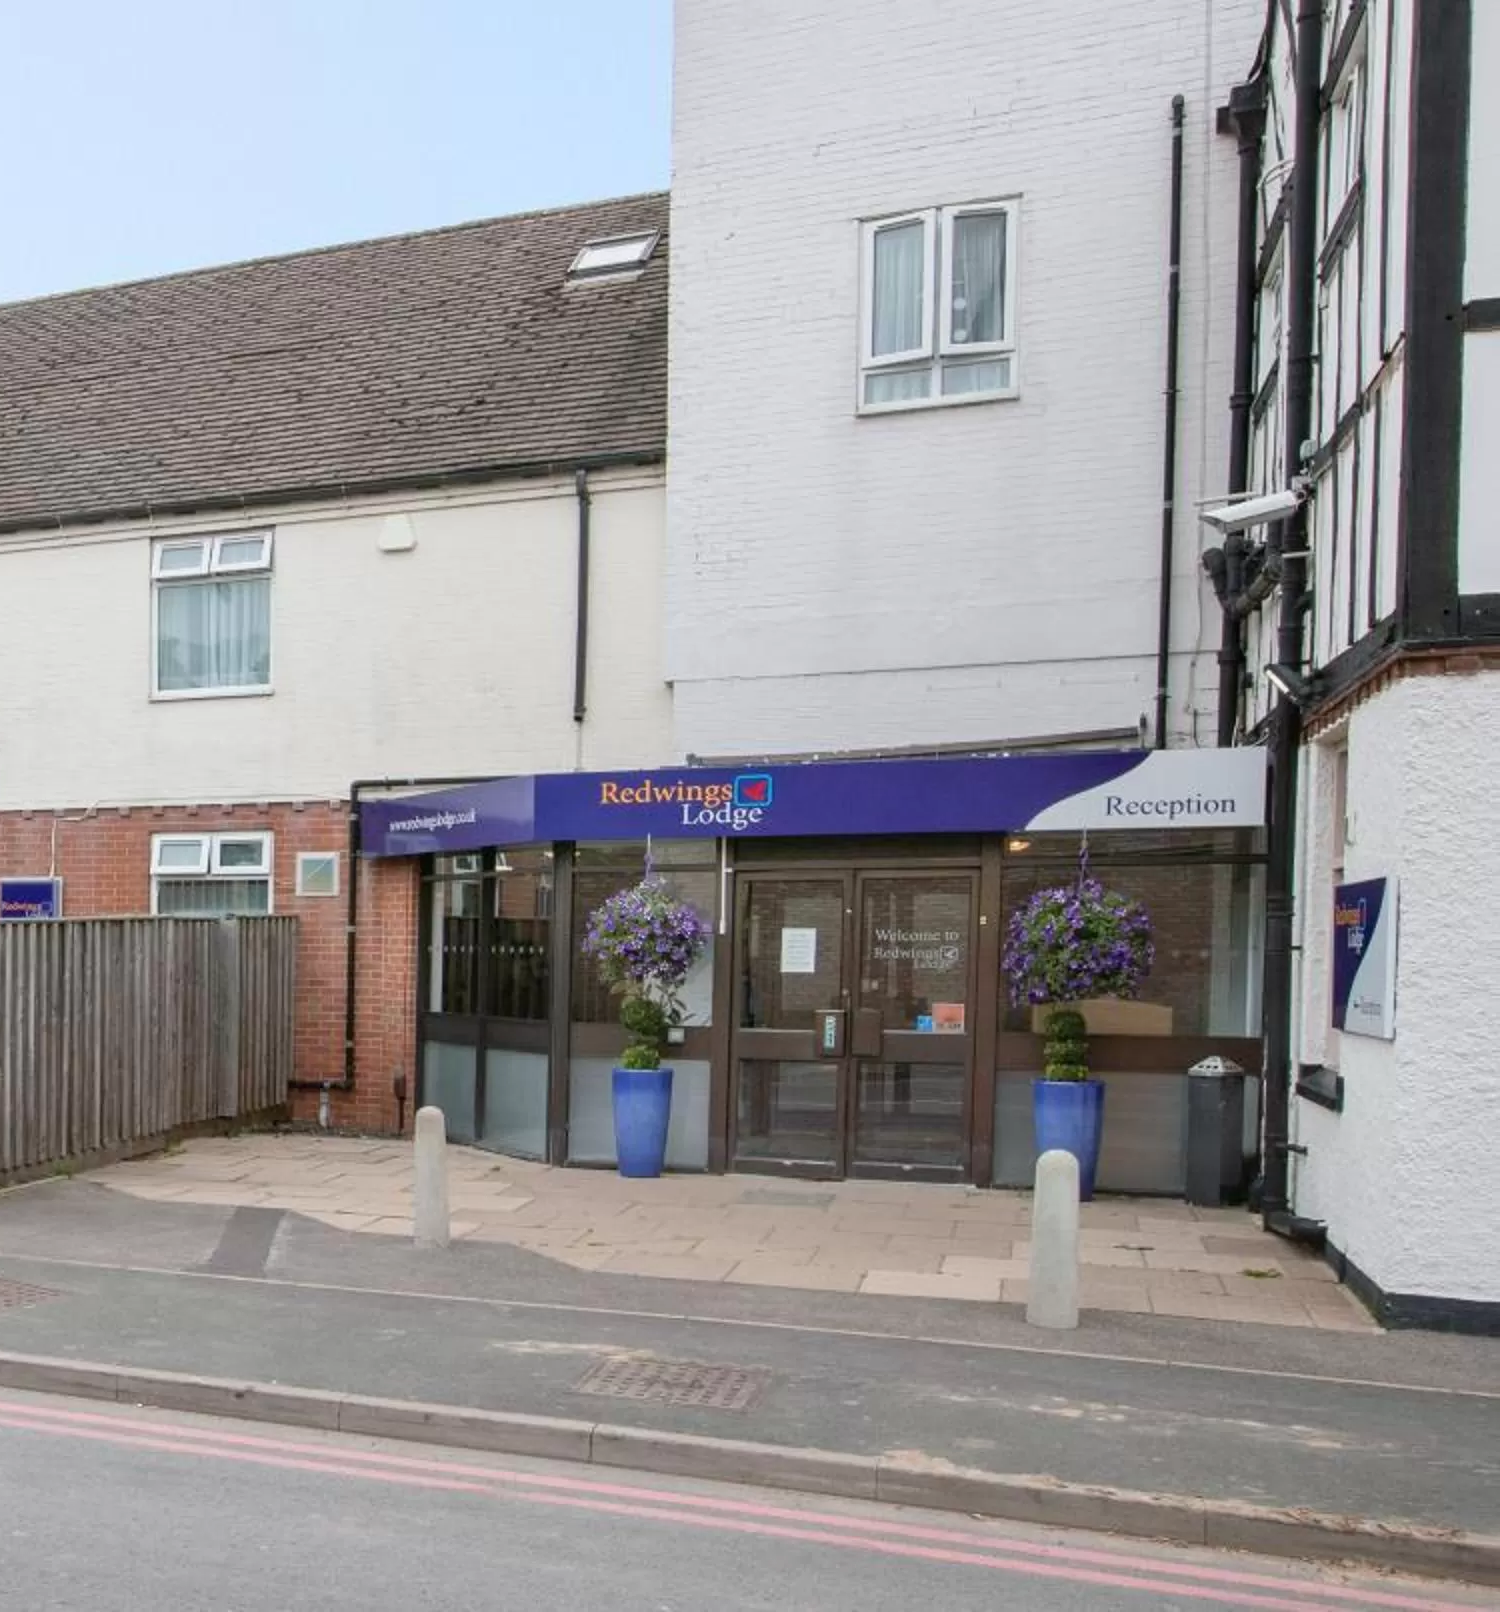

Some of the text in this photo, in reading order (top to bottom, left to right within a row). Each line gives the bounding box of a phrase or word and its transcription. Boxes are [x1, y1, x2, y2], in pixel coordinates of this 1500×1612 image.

[601, 779, 733, 808] Redwings
[1106, 793, 1236, 821] Reception
[682, 801, 763, 831] Lodge
[875, 928, 959, 941] Welcome to
